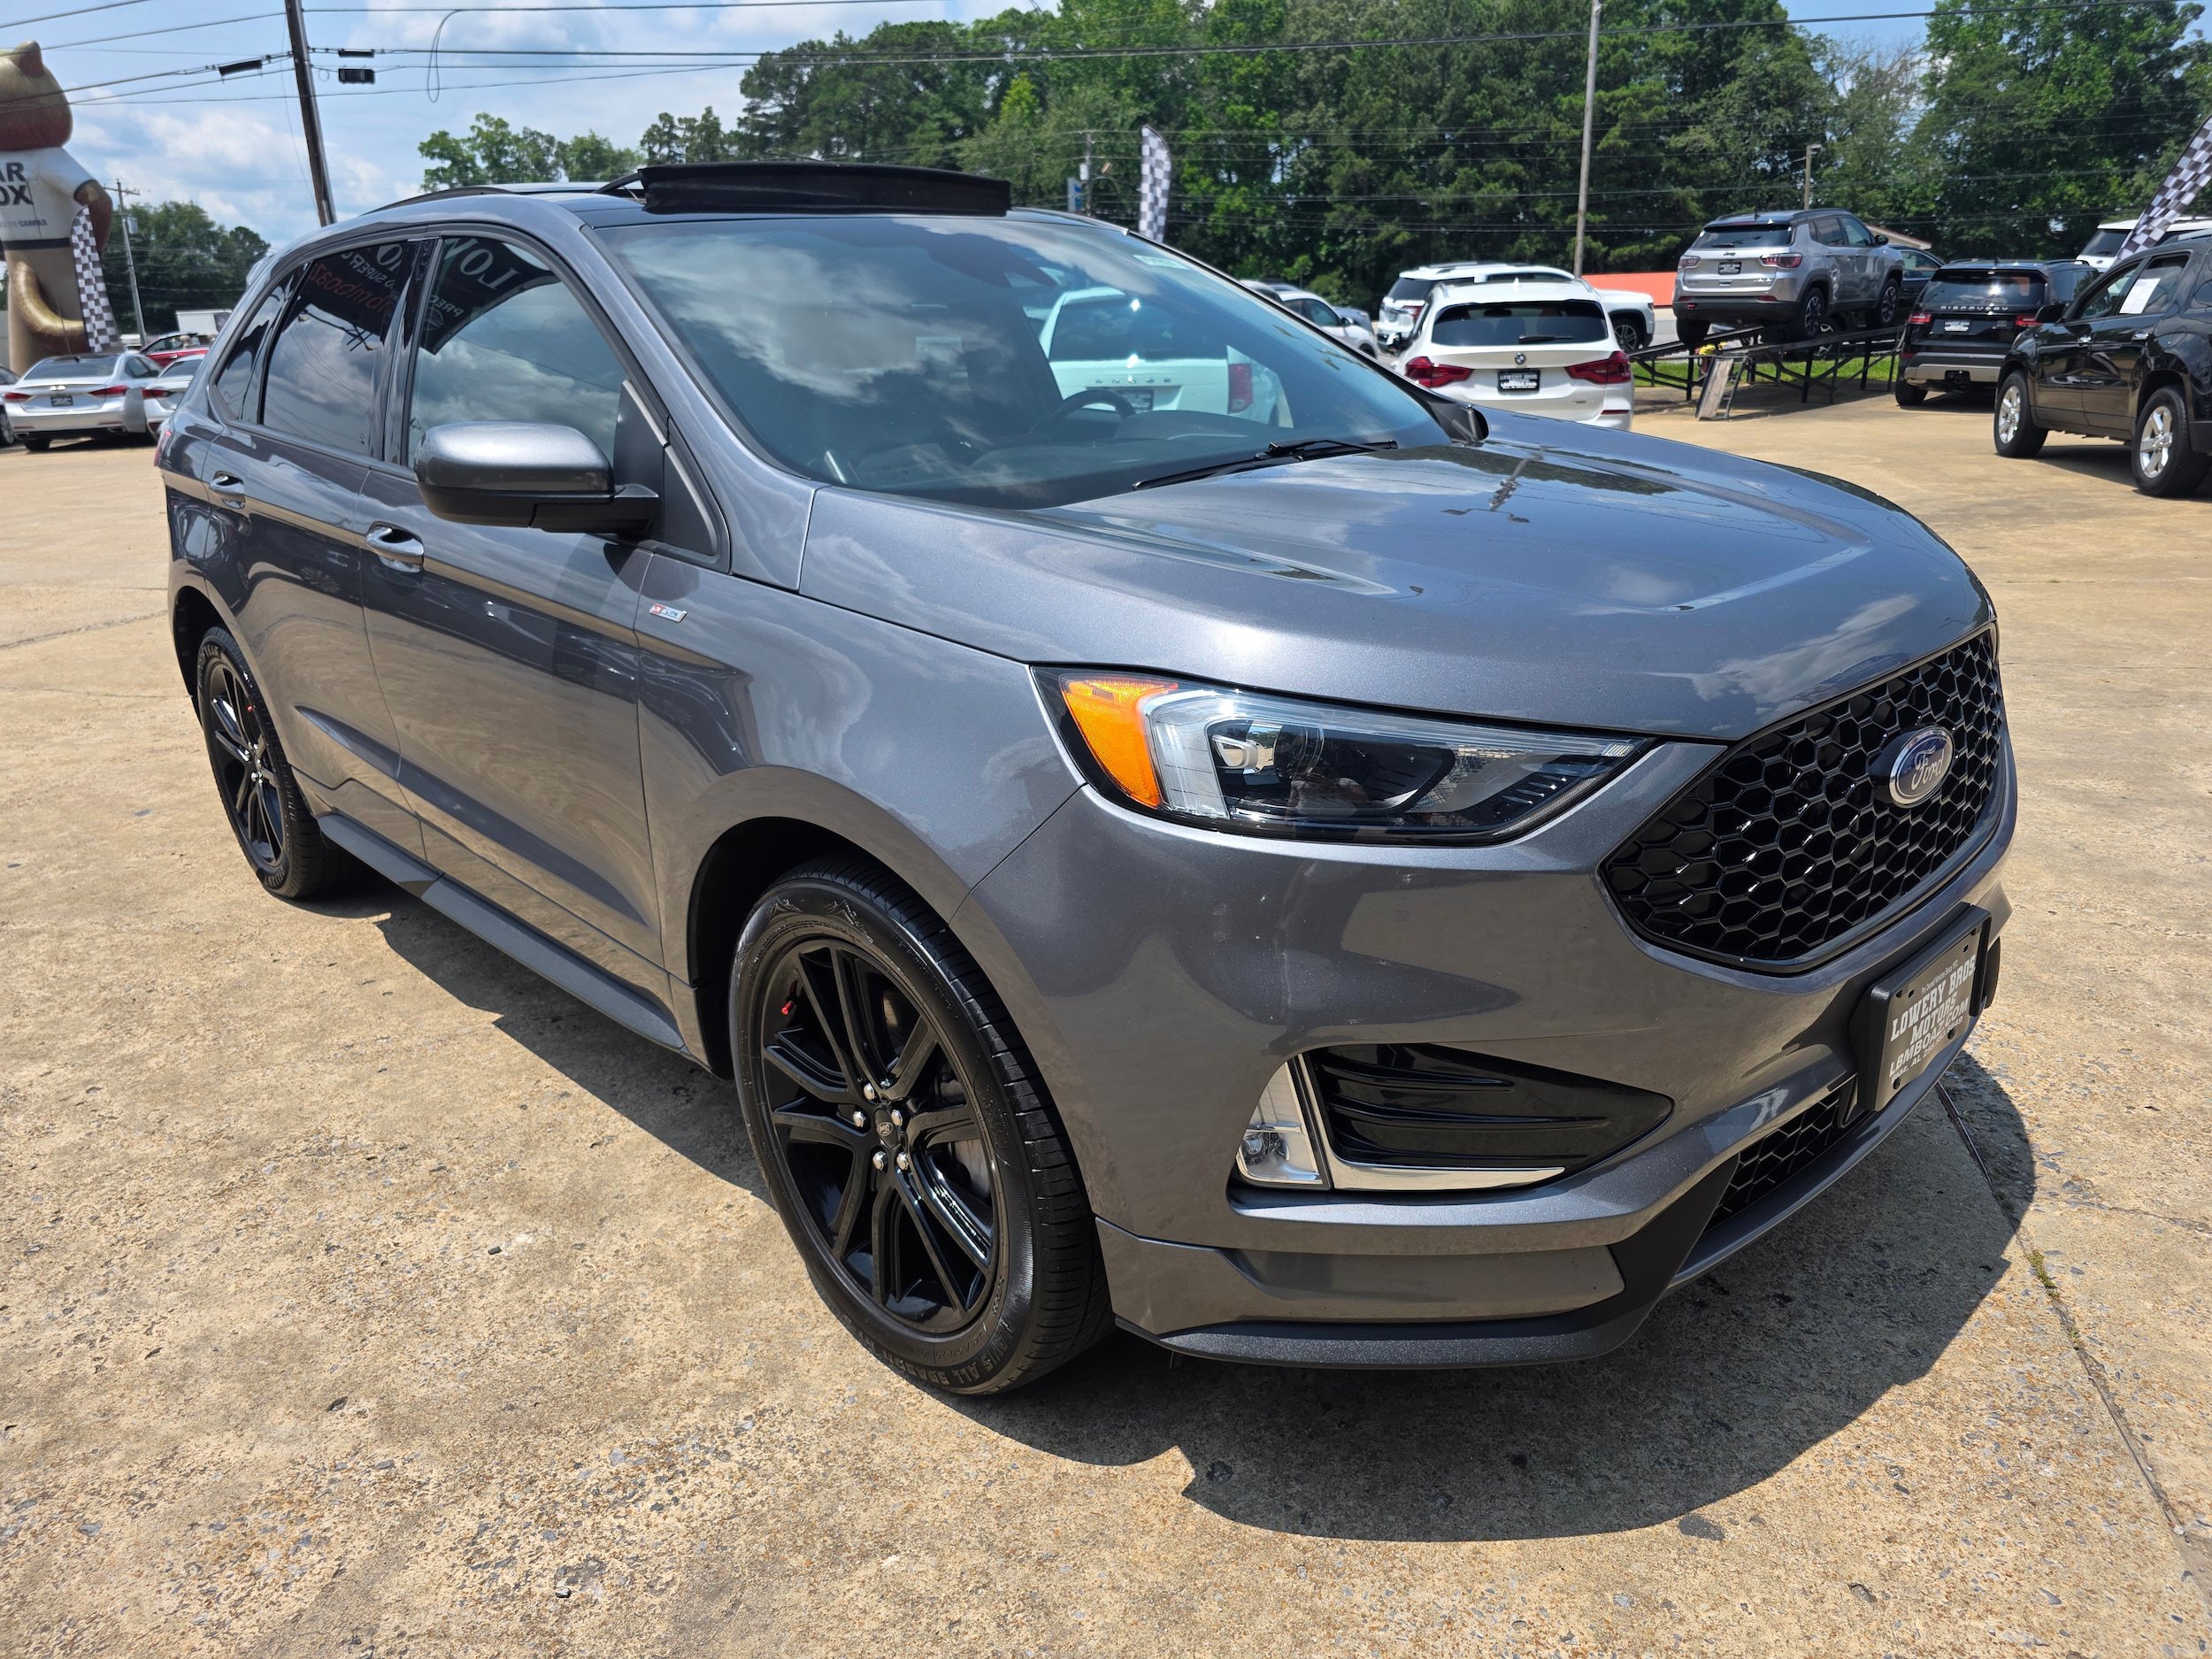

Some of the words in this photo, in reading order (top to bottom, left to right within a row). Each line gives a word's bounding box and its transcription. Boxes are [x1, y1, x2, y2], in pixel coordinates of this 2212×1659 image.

[1910, 744, 1945, 791] Ford
[1888, 997, 1970, 1079] LBMBOAZ.COM
[1890, 979, 1947, 1042] LOWERY
[1909, 990, 1958, 1046] MOTORS
